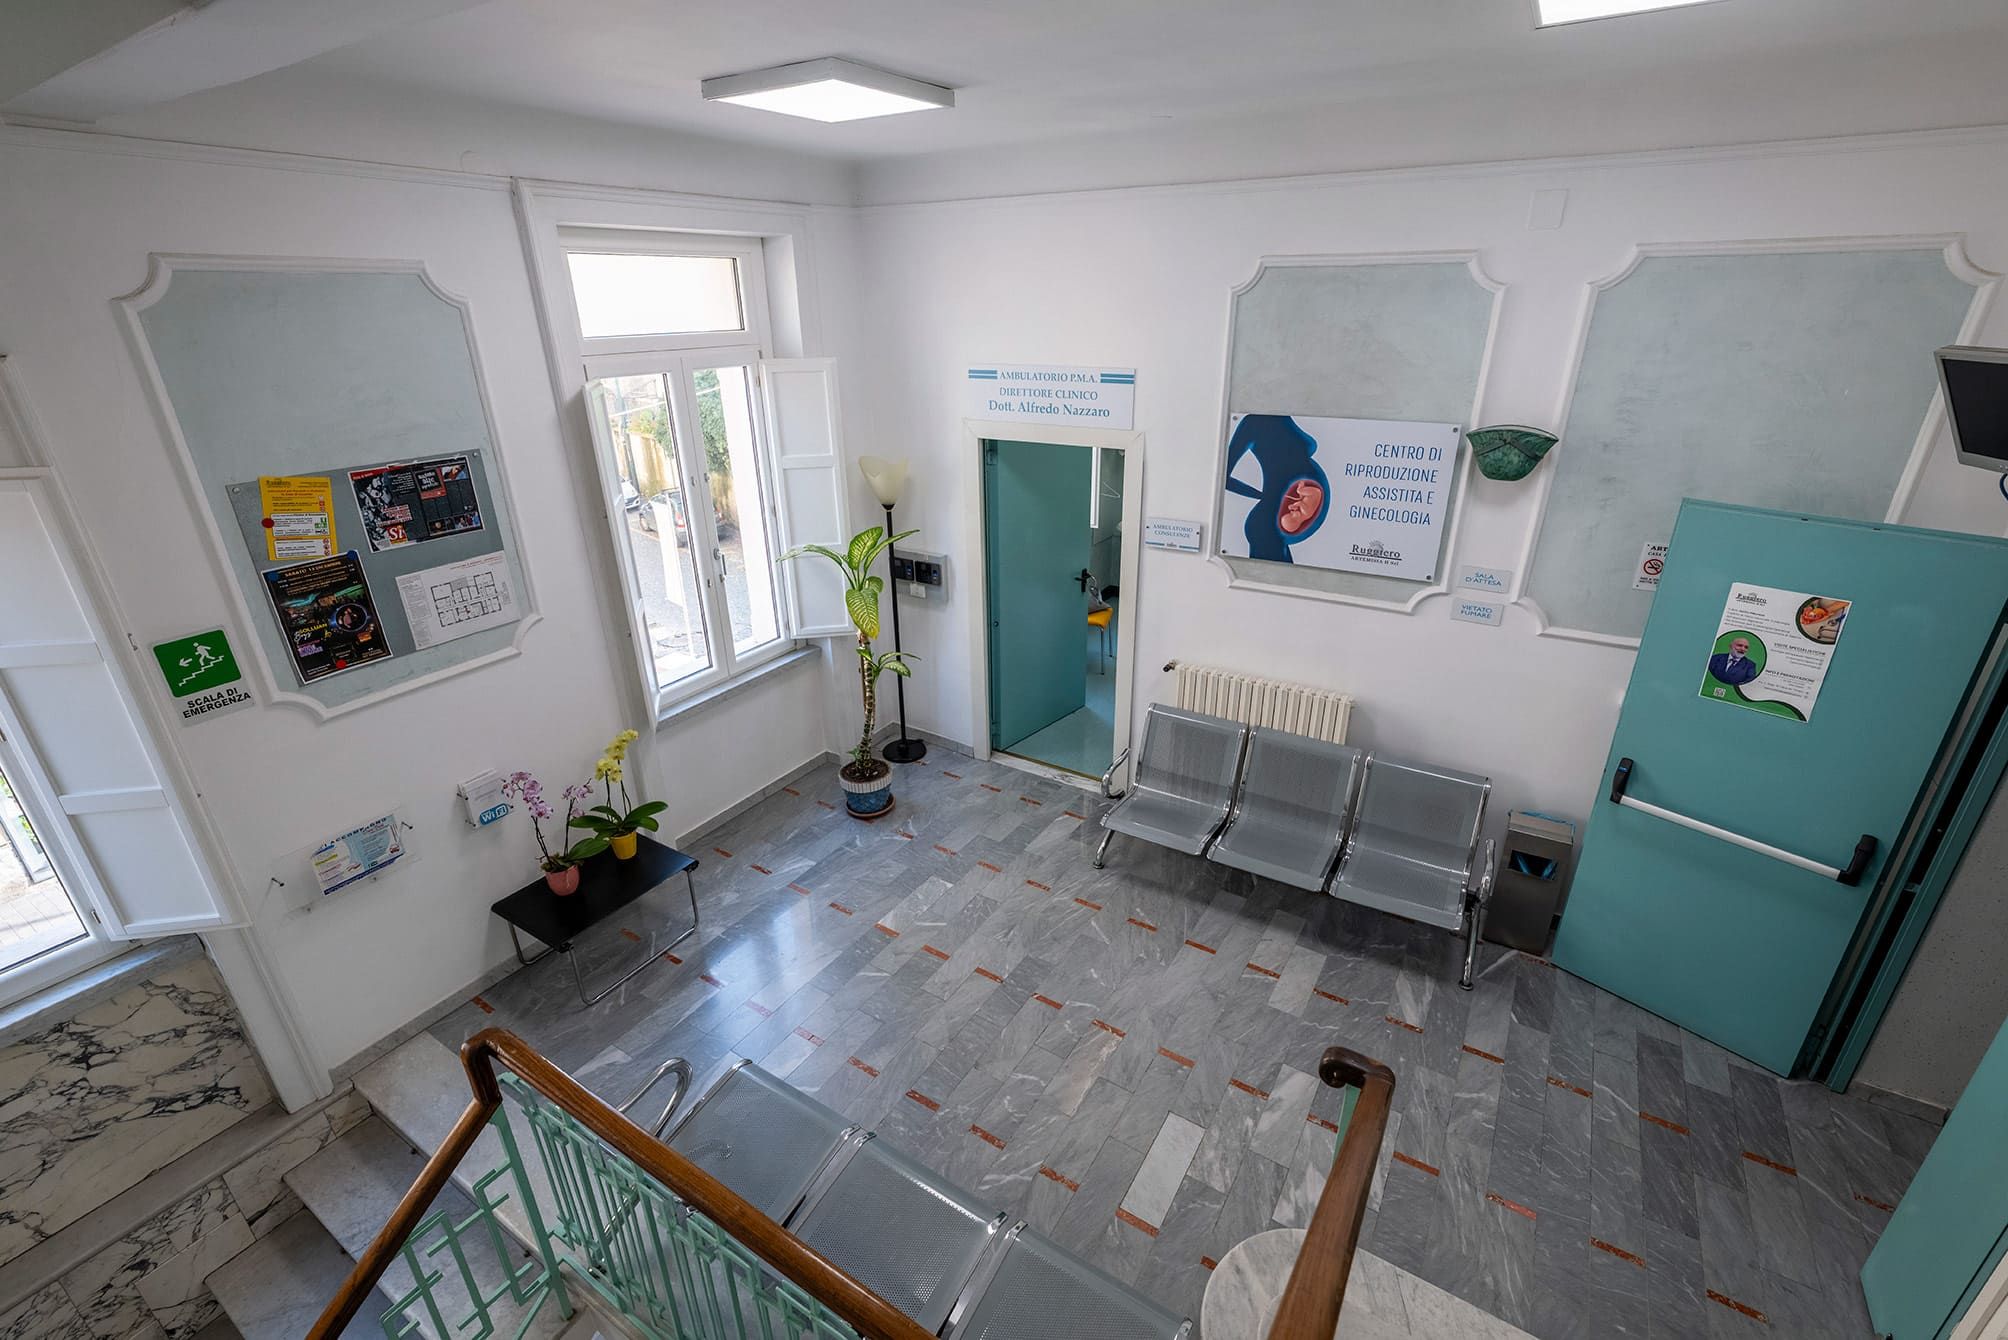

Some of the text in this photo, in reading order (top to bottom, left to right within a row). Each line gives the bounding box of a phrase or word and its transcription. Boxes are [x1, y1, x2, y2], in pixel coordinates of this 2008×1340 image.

[1000, 371, 1098, 383] AMBULATORIO P.M.A.
[1000, 387, 1098, 401] DIRETTORE CLINICO
[989, 400, 1110, 418] Dott. Alfredo Nazzaro
[1374, 444, 1443, 461] CENTRO DI
[1345, 463, 1438, 483] RIPRODUZIONE
[1363, 486, 1435, 505] ASSISTITA E
[1349, 505, 1431, 526] GINECOLOGIA
[1352, 544, 1401, 559] Ruggiero
[1465, 576, 1502, 586] D'ATTESA
[1474, 572, 1494, 580] SALA
[1460, 610, 1492, 620] FUMARE
[1462, 604, 1493, 614] VIETATO
[182, 692, 251, 718] EMERGENZA
[187, 688, 238, 708] SCALA DI
